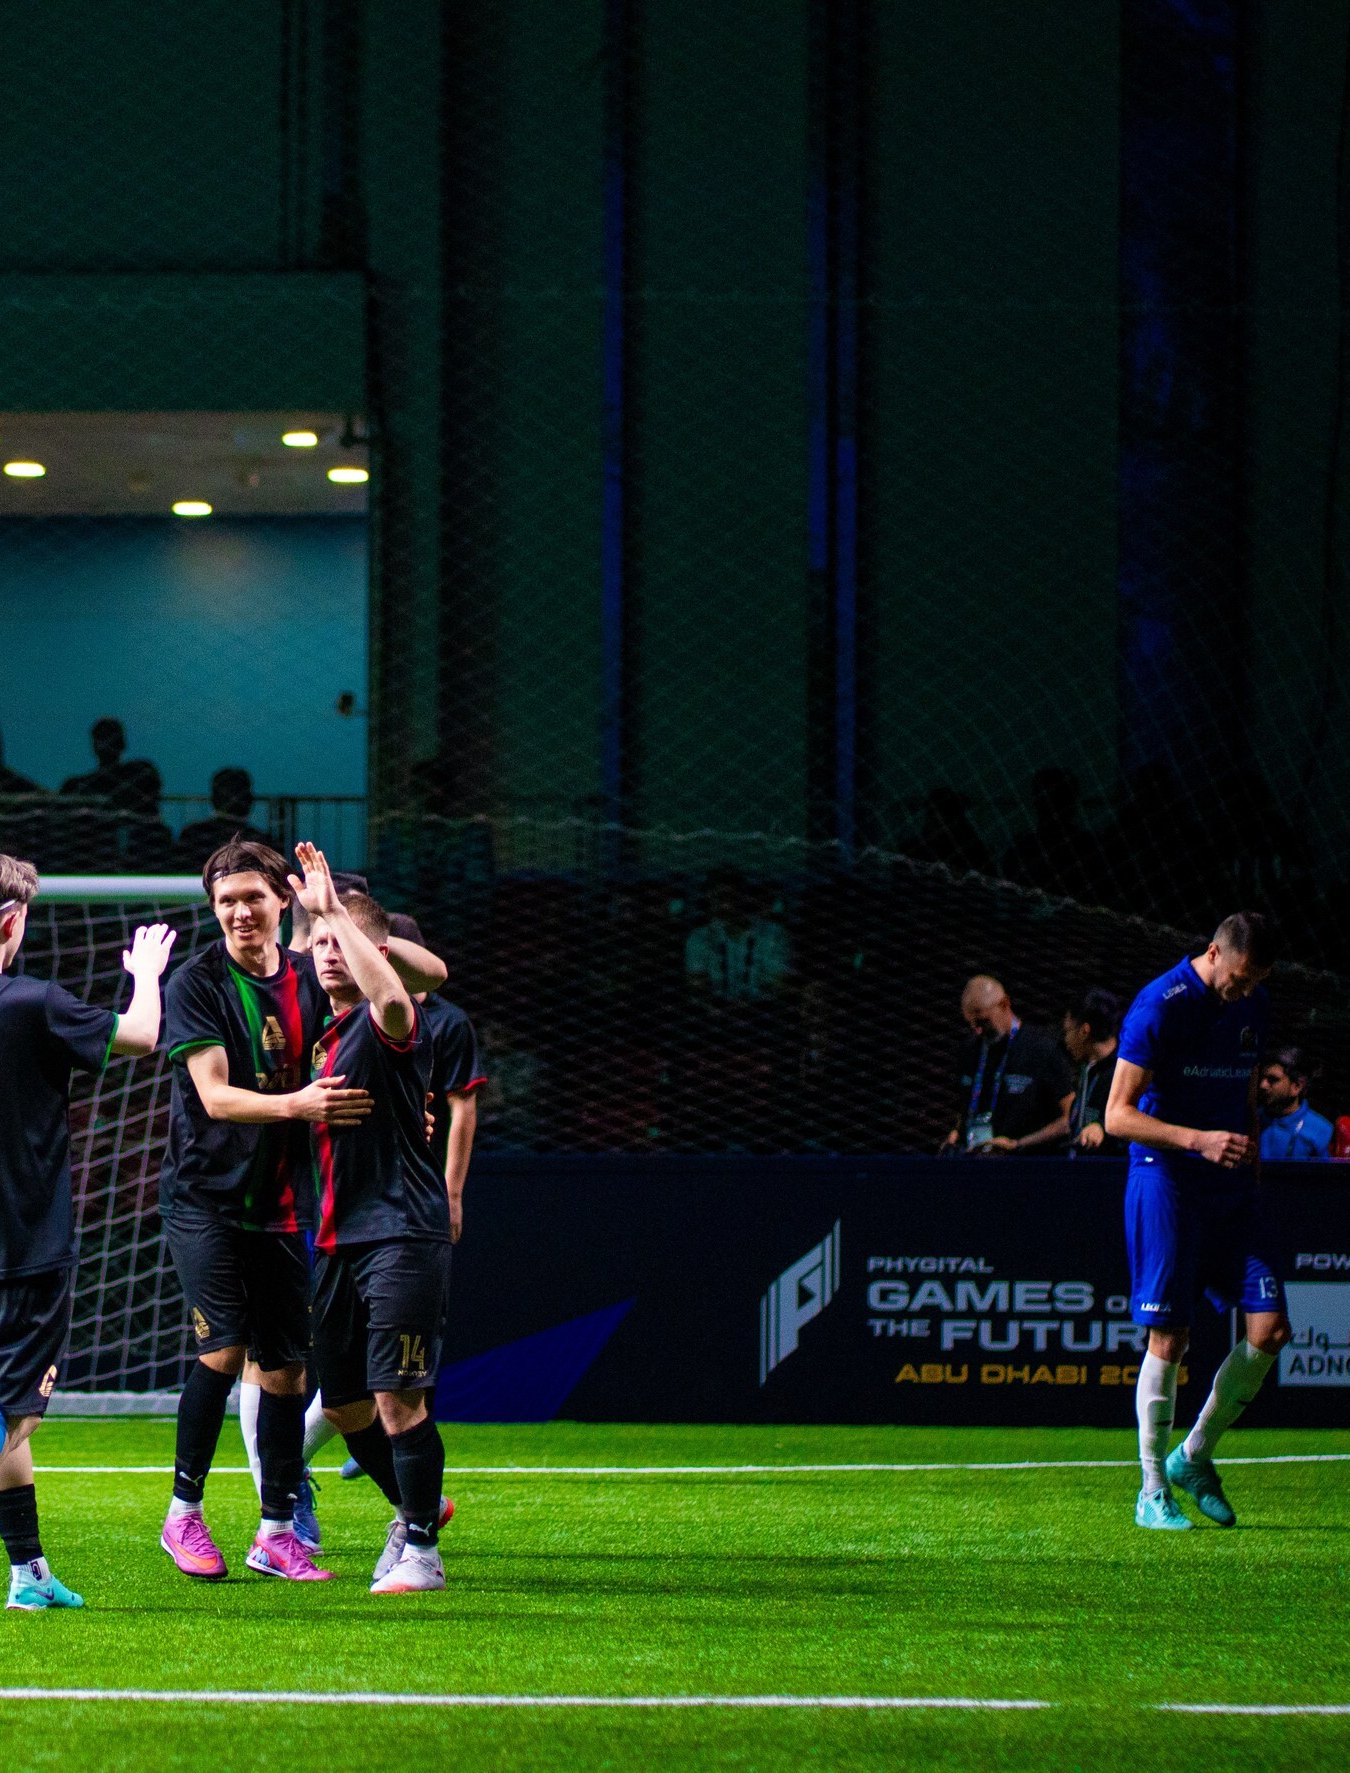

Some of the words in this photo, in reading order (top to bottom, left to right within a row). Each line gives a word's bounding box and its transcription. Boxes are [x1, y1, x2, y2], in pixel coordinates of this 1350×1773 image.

[867, 1257, 994, 1274] PHYGITAL
[867, 1280, 1095, 1313] GAMES
[1105, 1295, 1131, 1313] O
[1259, 1276, 1279, 1300] 13
[867, 1319, 931, 1337] THE
[940, 1320, 1148, 1351] FUTUR
[400, 1334, 425, 1370] 14
[894, 1363, 969, 1384] ABU
[980, 1364, 1088, 1385] DHABI
